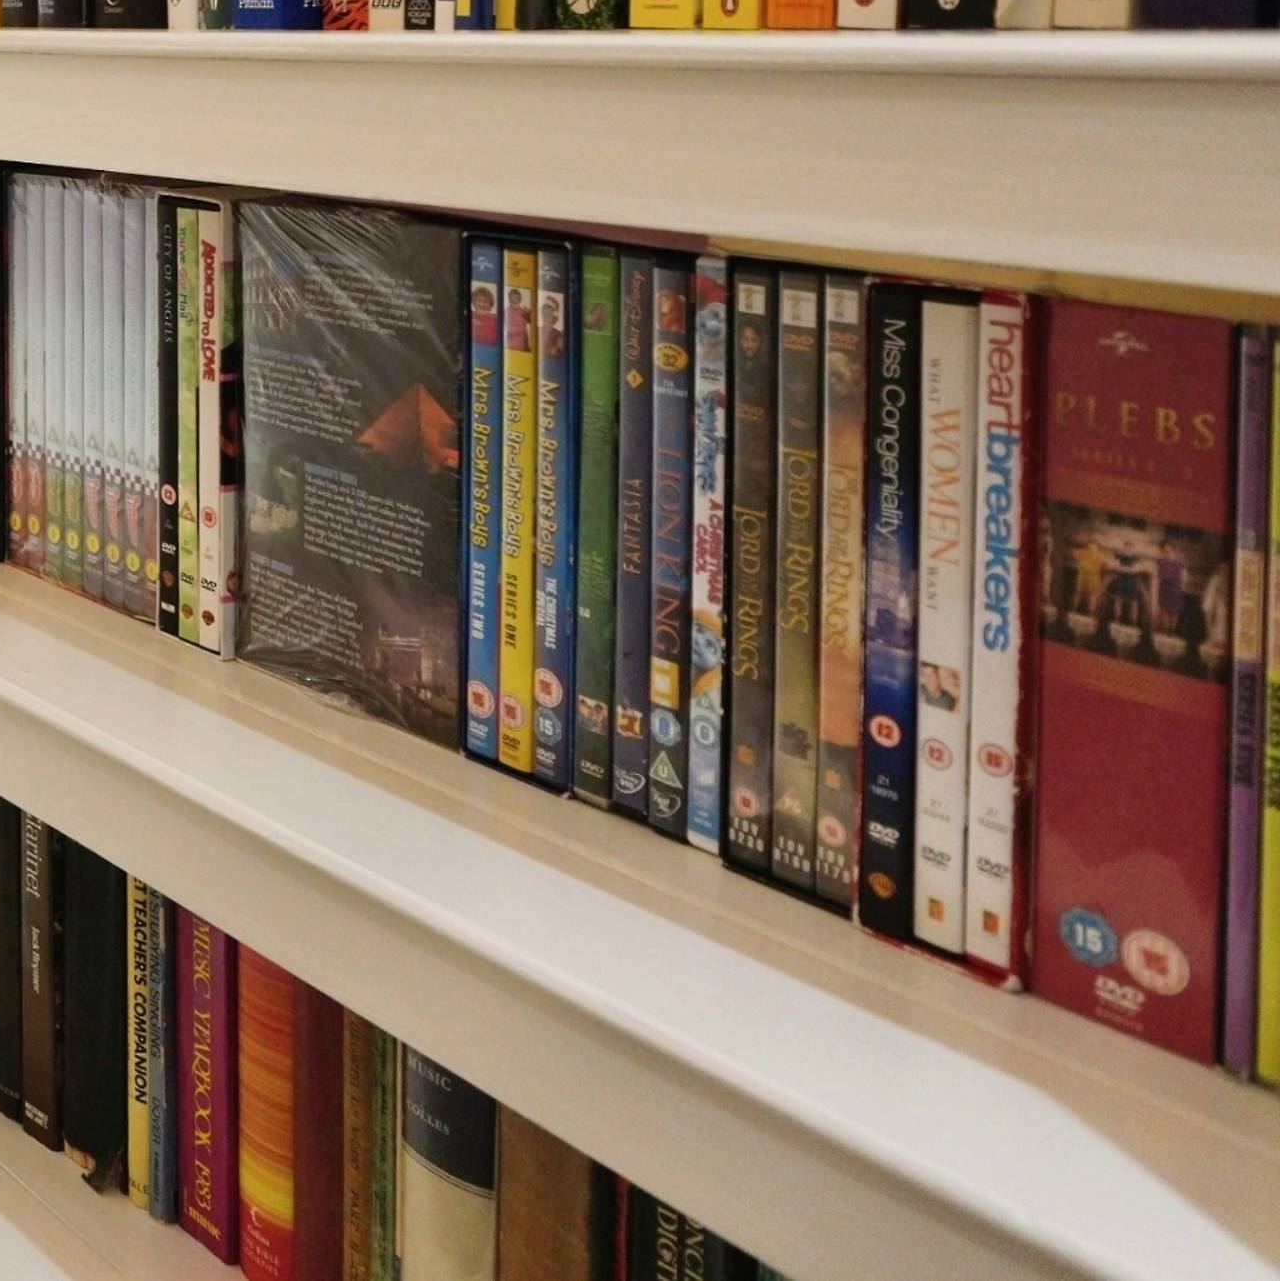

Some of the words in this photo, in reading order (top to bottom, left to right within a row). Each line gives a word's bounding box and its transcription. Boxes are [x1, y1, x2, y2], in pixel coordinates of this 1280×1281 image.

[201, 240, 216, 319] ADDICTED
[201, 338, 216, 381] LOVE
[883, 319, 906, 378] Miss
[927, 358, 942, 403] WHAT
[1056, 391, 1215, 449] PLEBS
[473, 422, 490, 499] Brown's
[504, 430, 525, 507] Brown's
[540, 437, 558, 517] Brown's
[875, 385, 906, 542] Congeniality
[927, 409, 960, 566] WOMEN
[983, 319, 1023, 653] heartbreakers
[470, 501, 490, 549] Boys
[623, 479, 643, 574] FANTASIA
[657, 447, 682, 544] LION
[503, 509, 522, 559] Boys
[539, 519, 557, 567] Boys
[472, 562, 485, 607] SERIES
[505, 573, 517, 619] SERIES
[656, 554, 681, 655] KING
[780, 542, 813, 633] RINGS
[927, 567, 938, 612] WANT
[472, 611, 484, 639] TWO
[505, 623, 517, 650] ONE
[734, 596, 763, 680] RINGS
[134, 894, 148, 986] TEACHER'S
[193, 919, 211, 1000] MUSIC
[1075, 923, 1102, 954] 15
[134, 991, 148, 1106] COMPANION
[193, 1008, 212, 1153] YEARBOOK
[407, 1054, 453, 1092] MUSIC
[407, 1101, 450, 1136] COLLES
[195, 1159, 212, 1212] 1983
